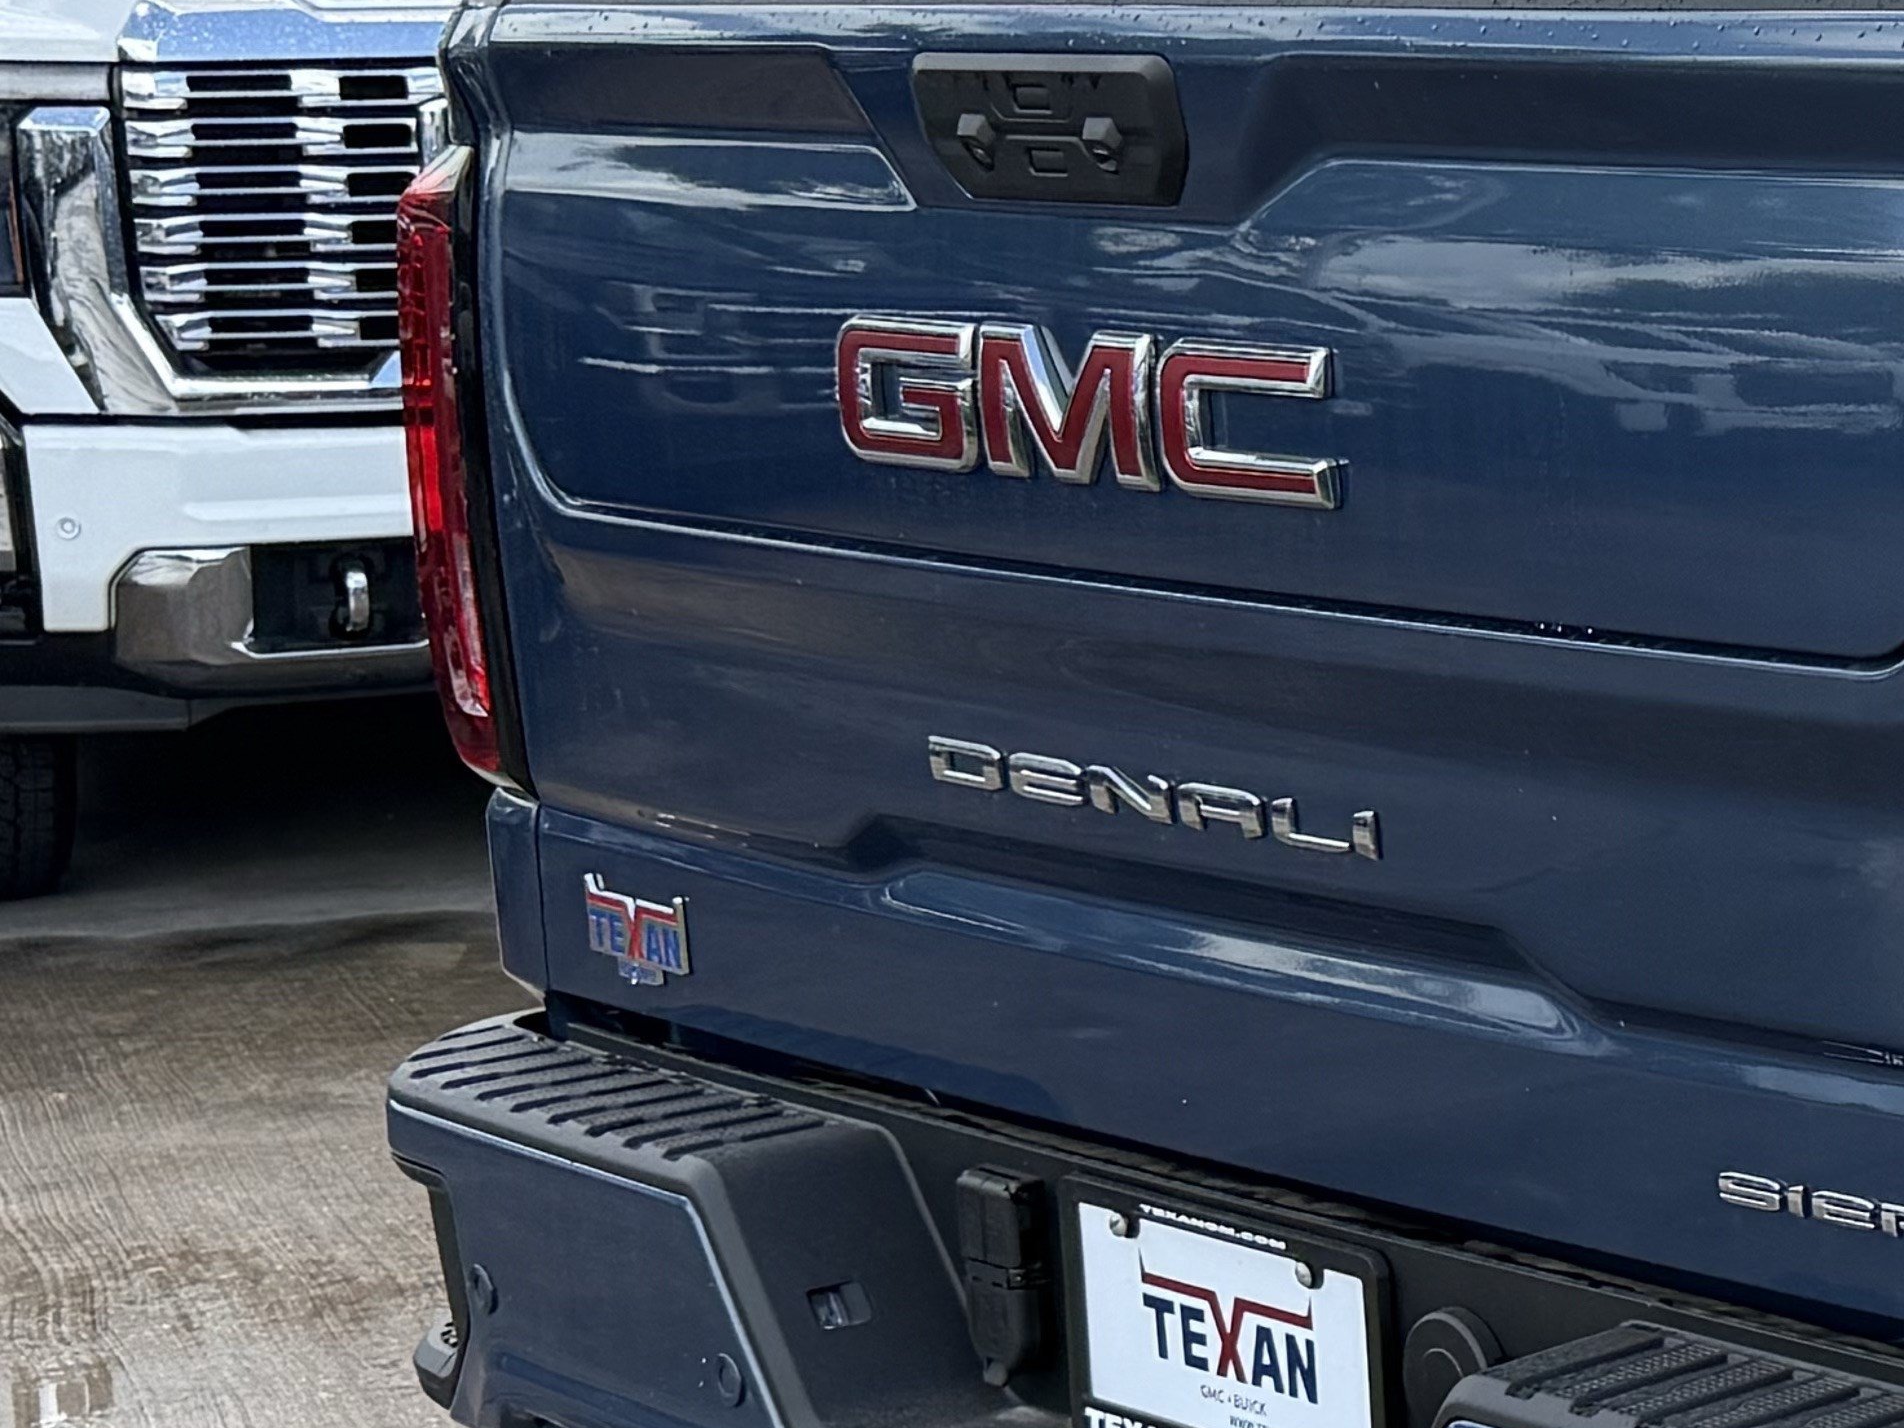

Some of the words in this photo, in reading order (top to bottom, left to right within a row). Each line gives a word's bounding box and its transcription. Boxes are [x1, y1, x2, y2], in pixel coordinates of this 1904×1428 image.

[836, 316, 1348, 510] GMC
[928, 735, 1384, 861] DENALI
[584, 872, 691, 976] TEXAN
[1138, 1250, 1319, 1405] TEXAN
